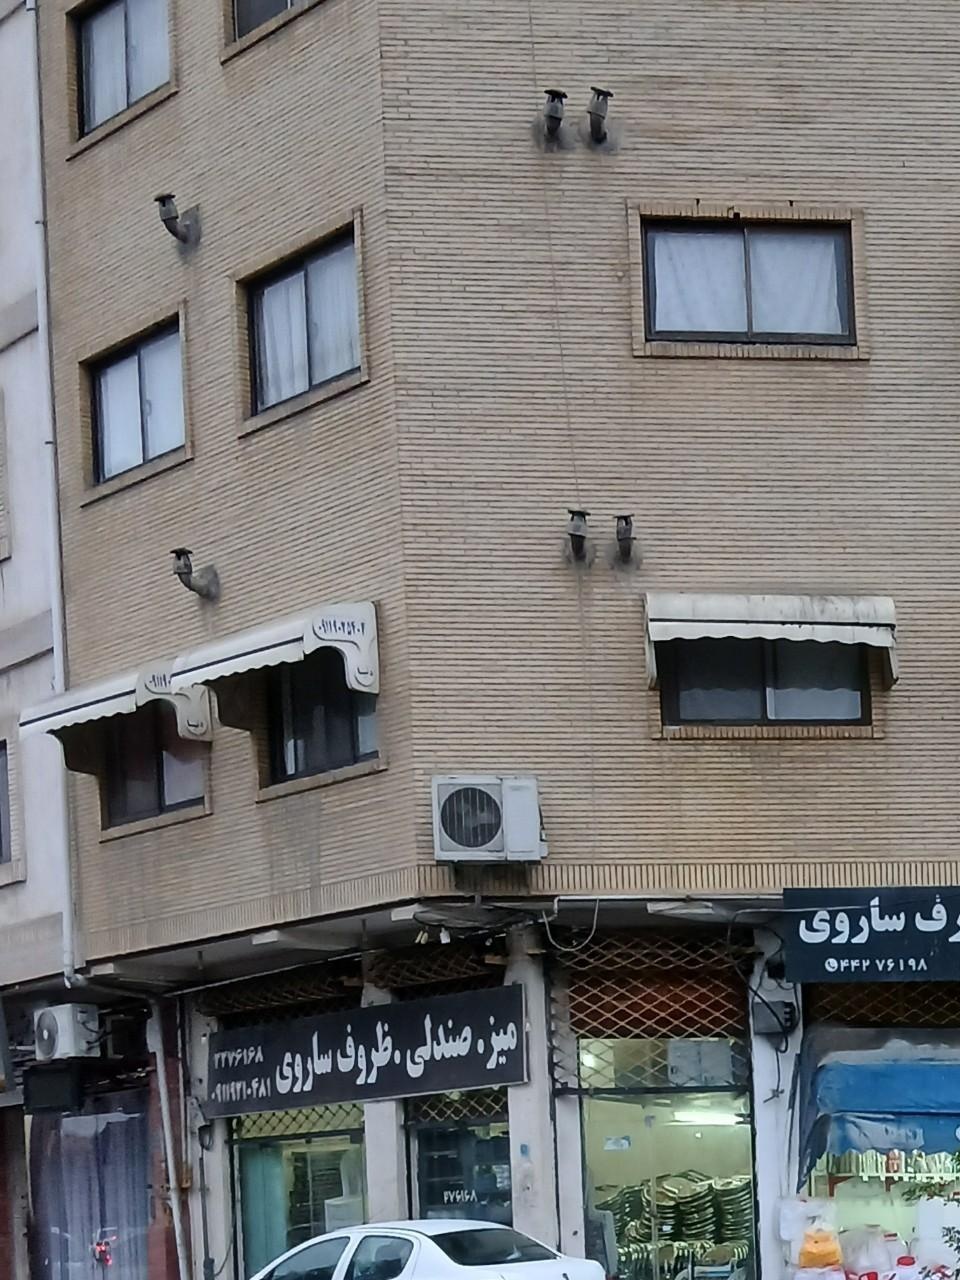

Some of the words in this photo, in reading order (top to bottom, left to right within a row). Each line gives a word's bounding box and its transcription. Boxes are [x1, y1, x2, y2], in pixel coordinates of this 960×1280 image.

[798, 896, 906, 944] ساروی
[275, 1030, 332, 1095] ساروی
[336, 1020, 393, 1086] ظروف
[406, 1013, 472, 1079] صندلی
[486, 1015, 517, 1070] میز
